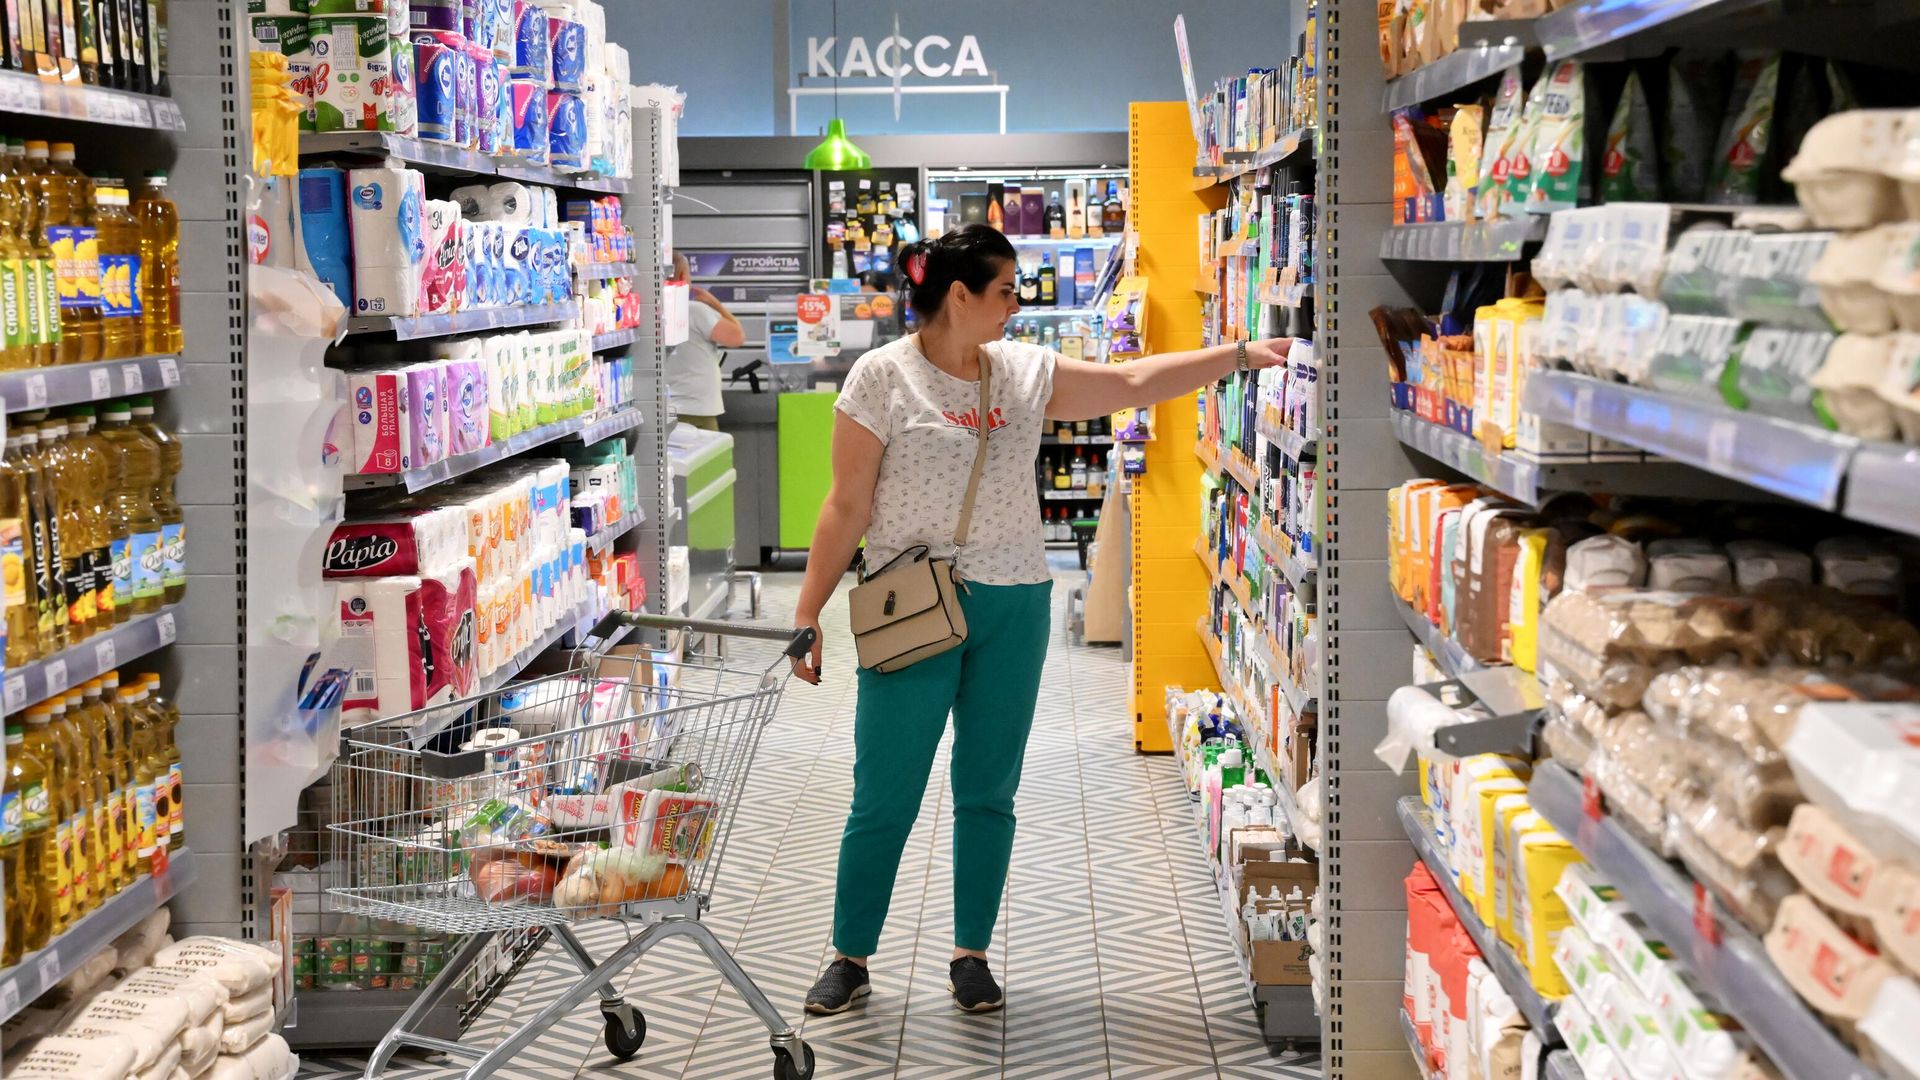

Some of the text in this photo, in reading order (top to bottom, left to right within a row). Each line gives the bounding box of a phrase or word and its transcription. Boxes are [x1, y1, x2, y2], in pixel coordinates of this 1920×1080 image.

[808, 35, 989, 78] КАССА
[732, 256, 800, 267] УСТРОЙСТВА
[799, 301, 826, 311] -15%
[381, 391, 389, 437] БОЛЬШАЯ
[388, 388, 396, 437] УПАКОВКА
[385, 457, 391, 467] 8
[175, 959, 217, 967] САХАР
[112, 999, 147, 1010] 1000
